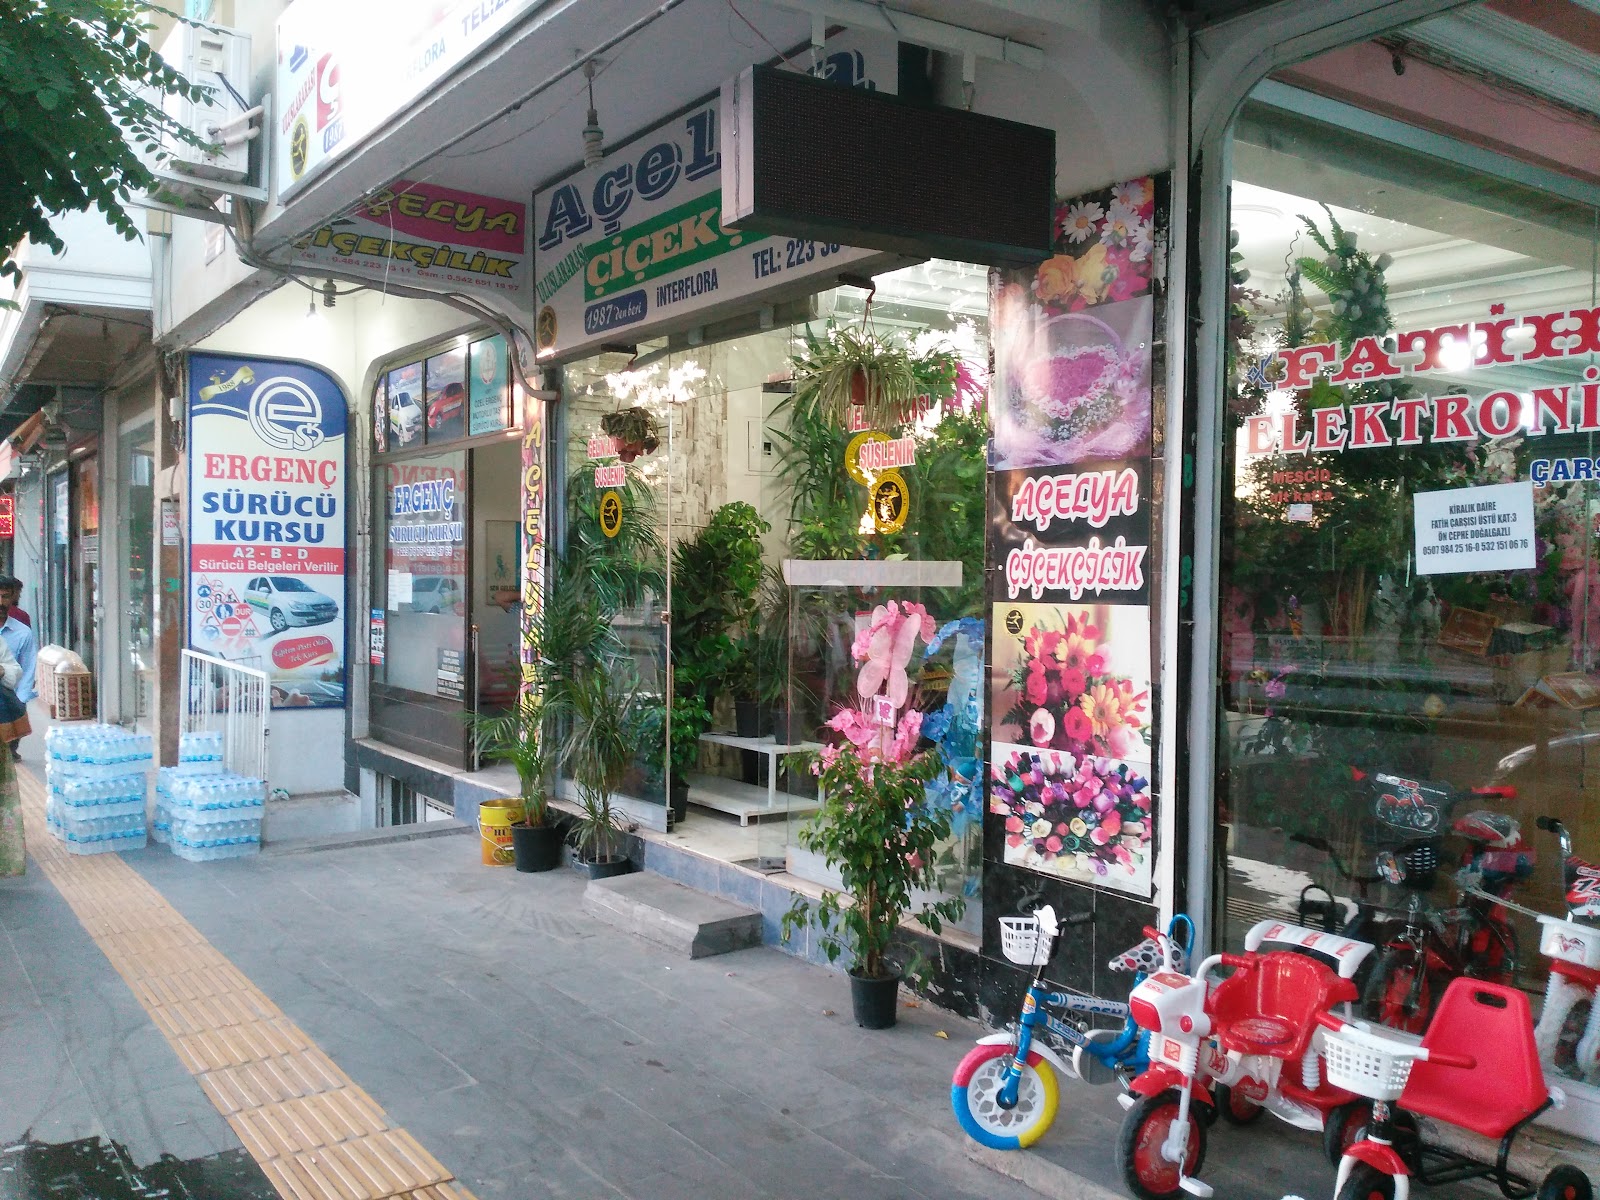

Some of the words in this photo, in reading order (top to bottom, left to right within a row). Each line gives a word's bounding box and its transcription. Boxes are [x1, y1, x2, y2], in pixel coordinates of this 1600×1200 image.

[364, 188, 518, 235] ÇELYA
[859, 433, 915, 470] SÜSLENİR
[204, 453, 337, 490] ERGENÇ
[1272, 467, 1331, 484] MESCİD
[202, 488, 336, 518] SÜRÜCÜ
[394, 478, 455, 520] ERGENÇ
[1013, 469, 1137, 529] AÇELYA
[1449, 503, 1476, 515] KİRALIK
[1477, 501, 1496, 513] DAİRE
[214, 519, 325, 544] KURSU
[427, 521, 463, 543] KURSU
[1431, 518, 1449, 529] FATİH
[1450, 516, 1477, 530] ÇARŞISI
[1478, 513, 1496, 525] ÜSTÜ
[1498, 512, 1517, 524] KAT:3
[1438, 530, 1448, 541] ÖN
[1449, 530, 1469, 541] CEPHE
[1470, 527, 1511, 539] DOĞALGAZLI
[232, 547, 255, 559] A2
[271, 547, 282, 559] B
[297, 548, 309, 560] D
[1423, 545, 1440, 556] 0507
[1454, 543, 1464, 553] 25
[1481, 541, 1495, 551] 532
[1496, 540, 1508, 550] 151
[1509, 539, 1519, 549] 06
[199, 559, 244, 571] Sürücü
[247, 560, 301, 573] Belgeleri
[304, 561, 340, 572] Verilir
[1007, 538, 1145, 598] ÇİÇEKÇİLİK
[198, 600, 212, 609] 30
